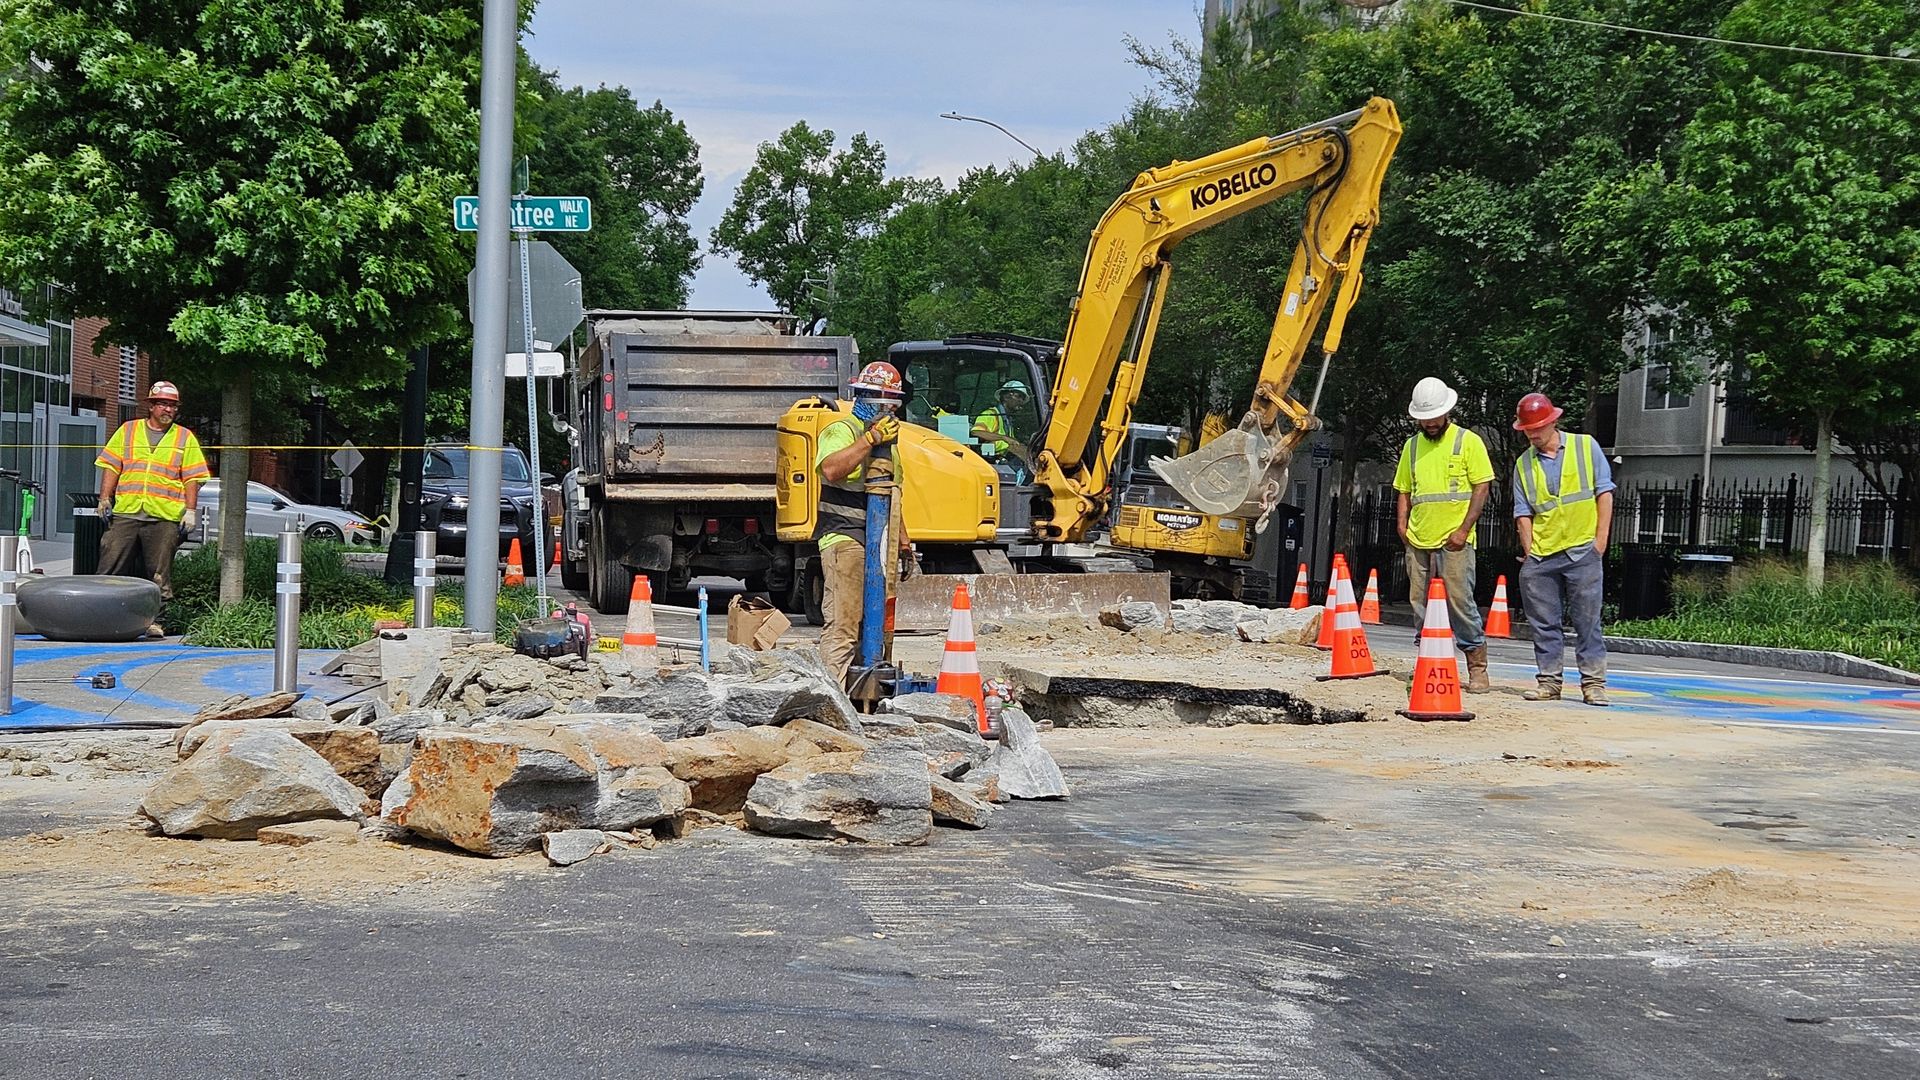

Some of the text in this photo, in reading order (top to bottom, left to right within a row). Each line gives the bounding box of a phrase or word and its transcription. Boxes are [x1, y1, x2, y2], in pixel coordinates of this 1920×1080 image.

[1190, 163, 1277, 210] KOBELCO
[559, 200, 584, 213] WALK
[461, 201, 555, 226] Petree
[565, 215, 578, 228] NE
[1428, 667, 1453, 679] ATL
[1425, 683, 1454, 695] DOT
